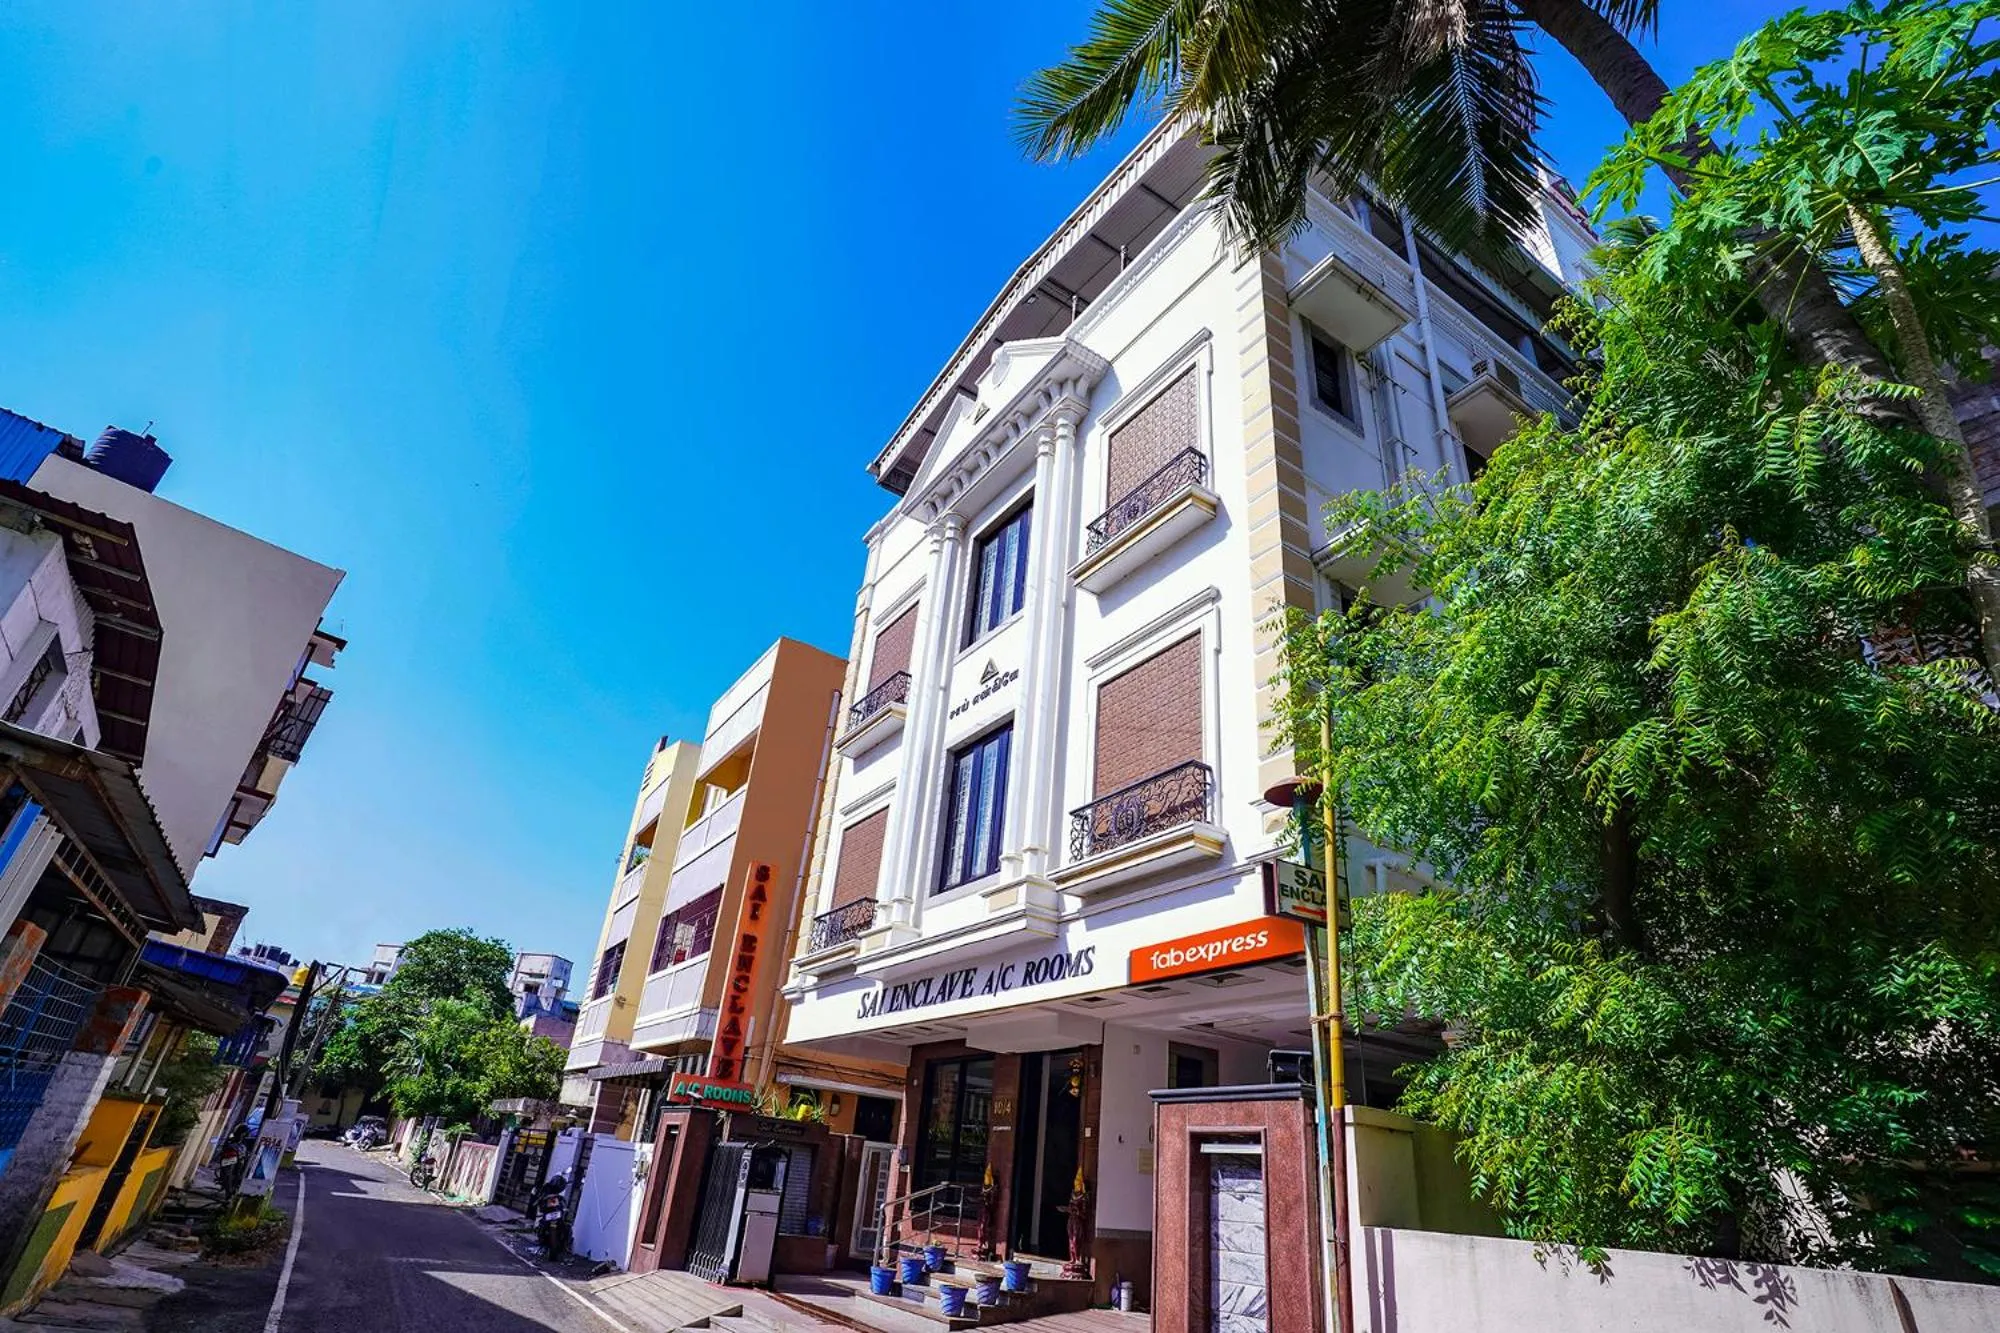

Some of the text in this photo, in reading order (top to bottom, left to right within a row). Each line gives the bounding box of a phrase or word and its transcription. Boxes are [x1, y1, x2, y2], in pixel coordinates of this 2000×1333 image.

[750, 864, 771, 921] SAI
[1150, 930, 1269, 970] fabexpress
[717, 934, 758, 1080] ENCLAVE
[857, 945, 1096, 1019] SAI ENCLAVE A/C ROOMS
[703, 1084, 752, 1104] ROOMS
